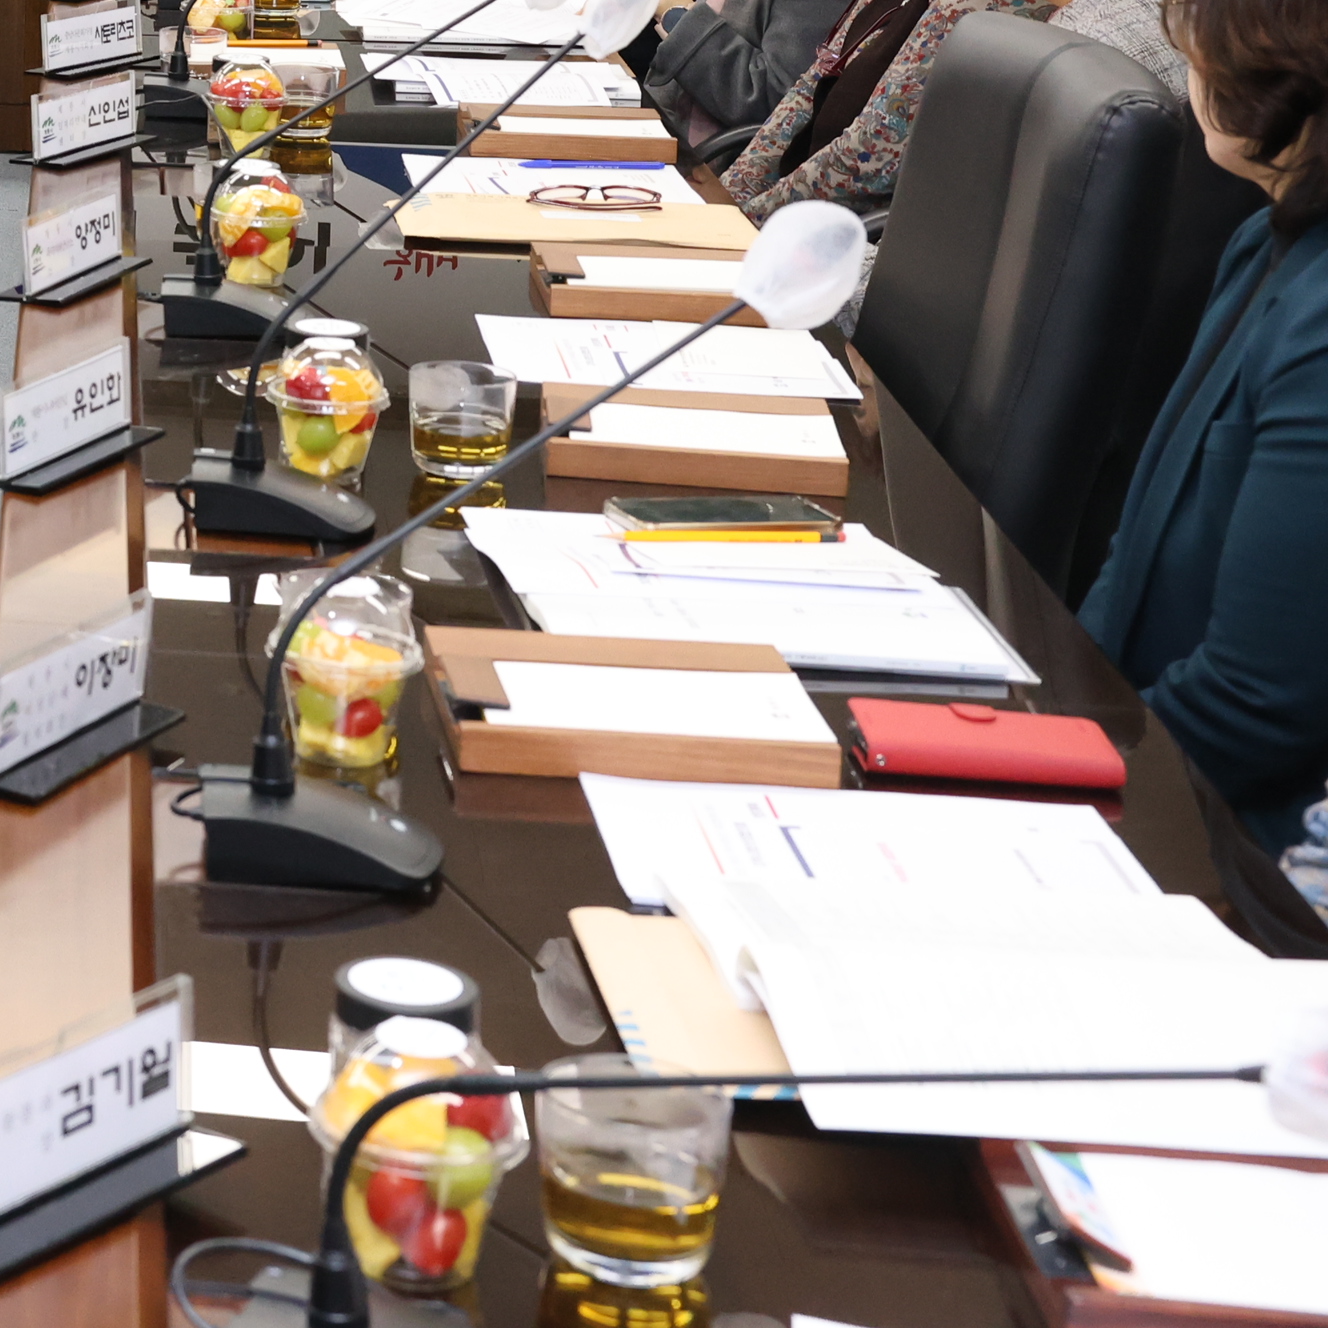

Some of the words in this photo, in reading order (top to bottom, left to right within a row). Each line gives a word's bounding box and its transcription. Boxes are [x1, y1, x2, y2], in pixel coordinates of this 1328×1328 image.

[87, 96, 130, 128] 신인섭
[75, 211, 116, 250] 양정미
[60, 1037, 175, 1139] 김기월
